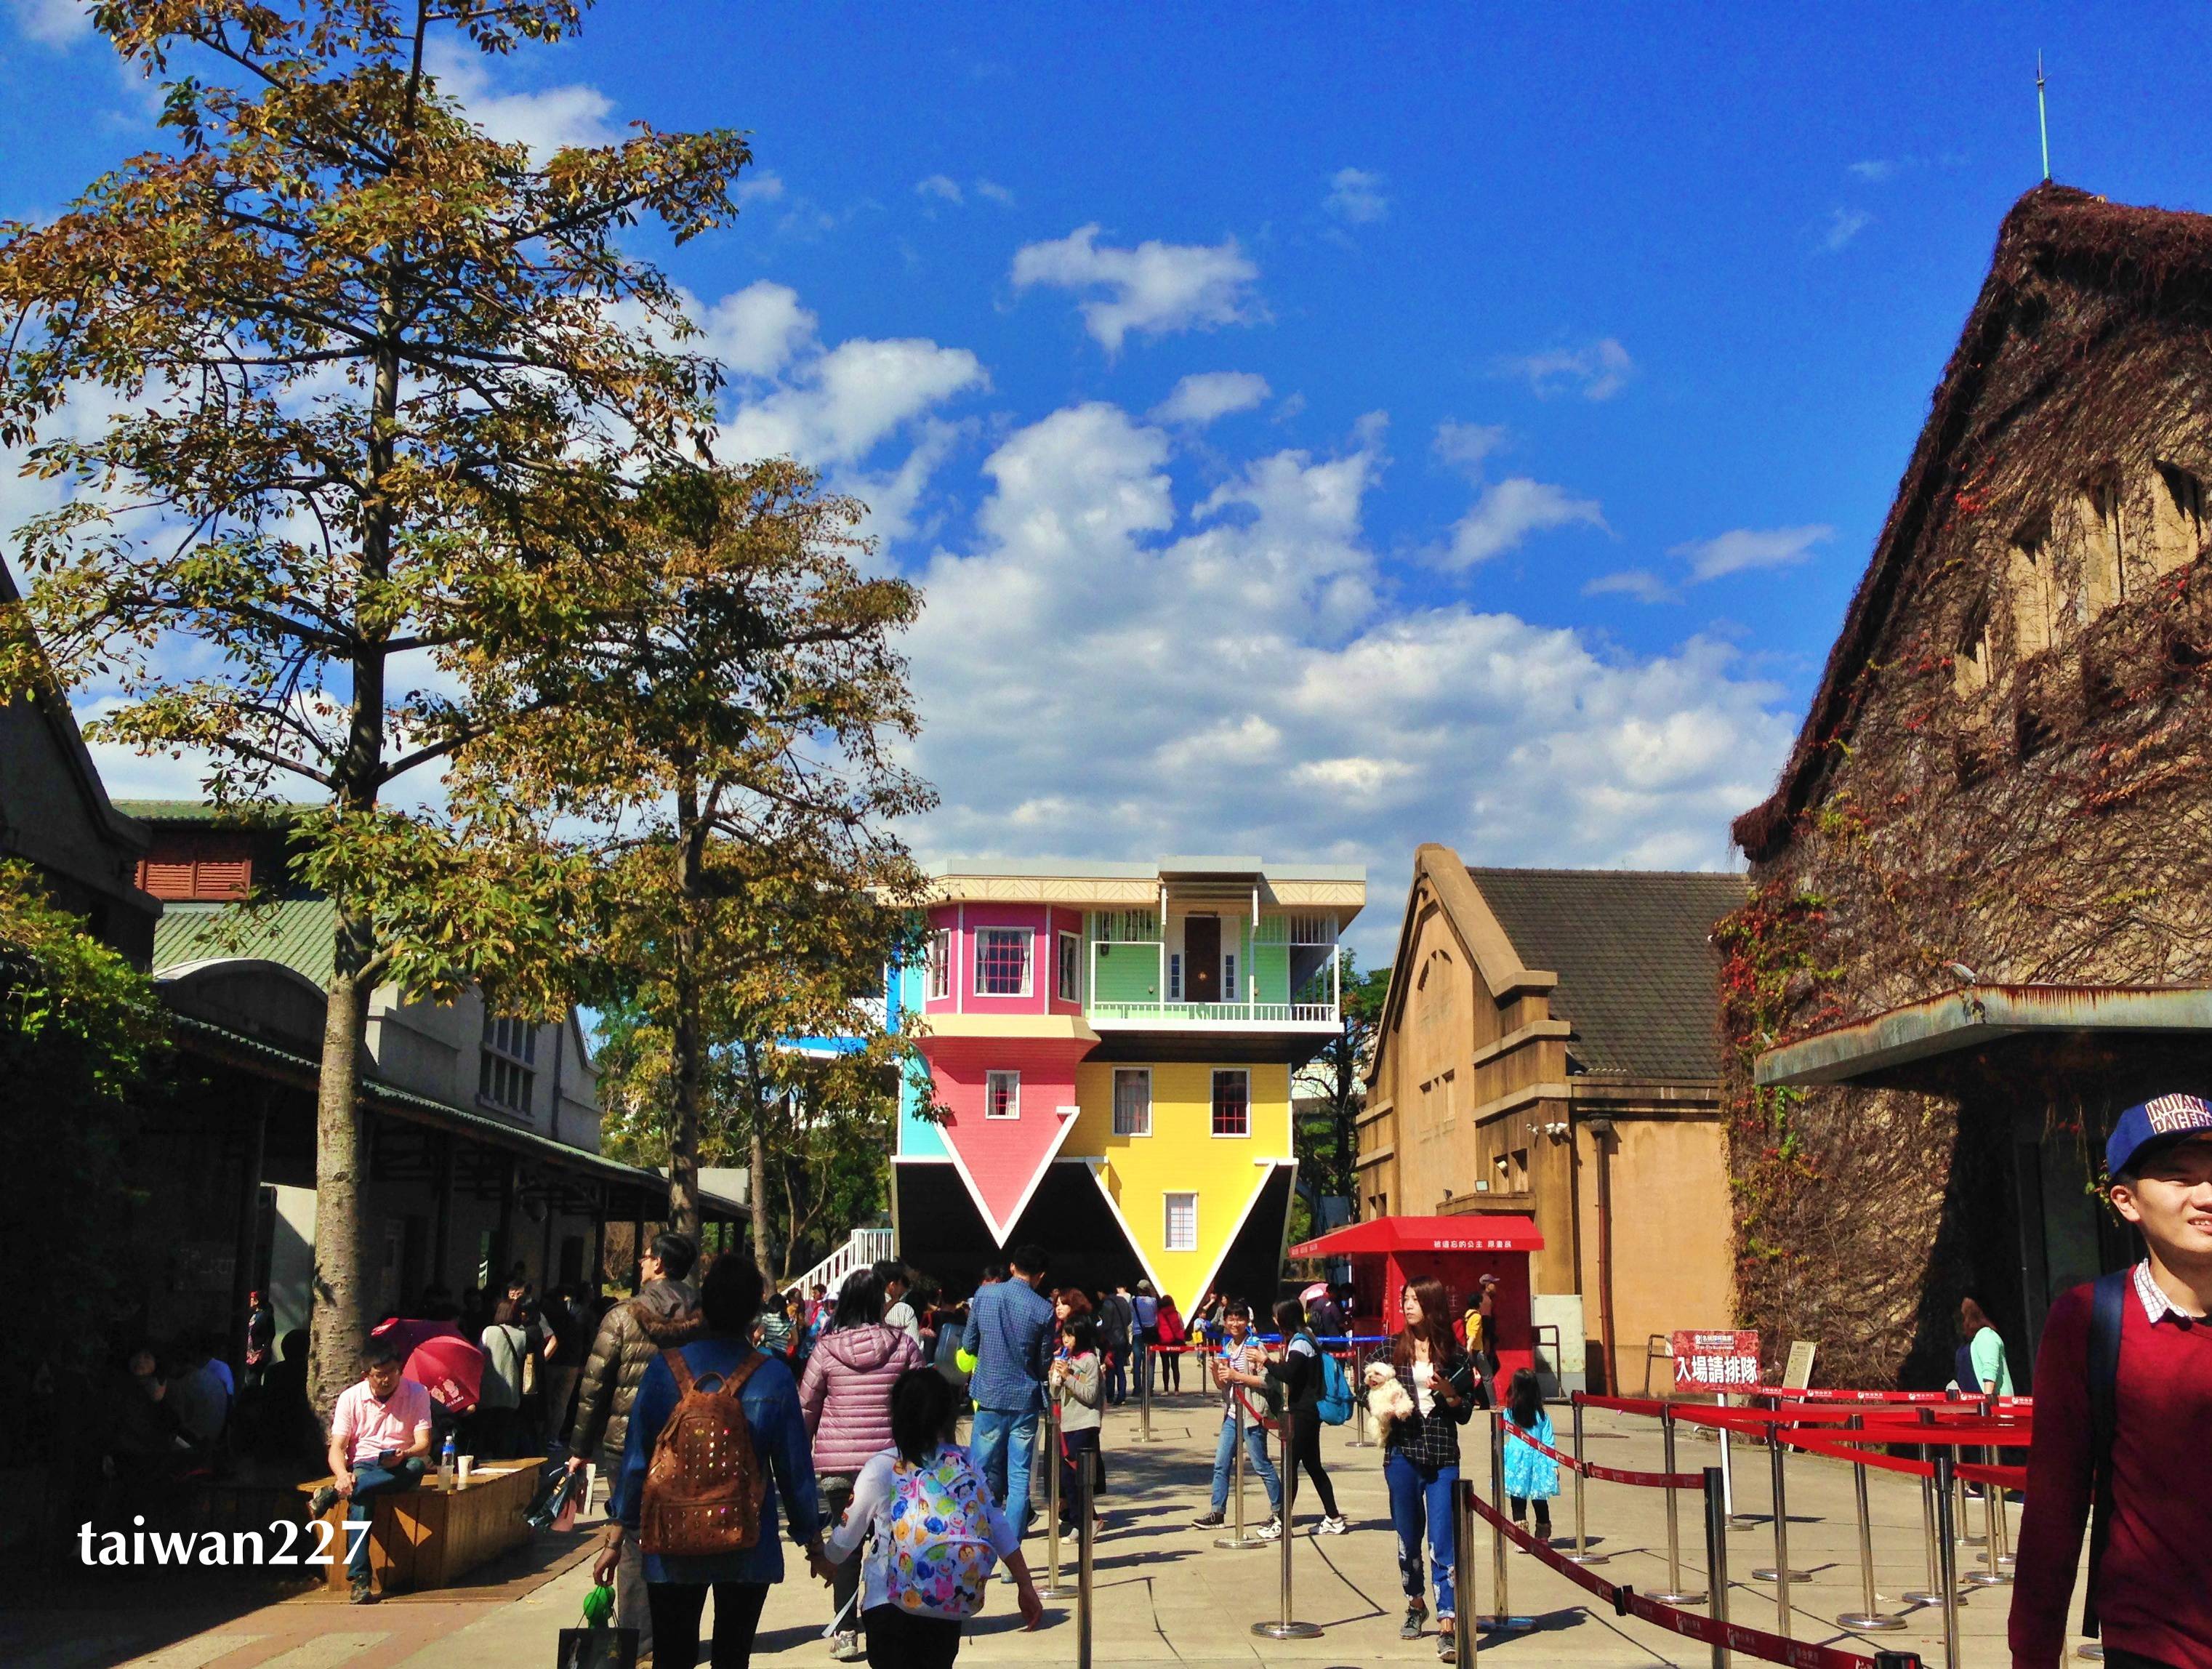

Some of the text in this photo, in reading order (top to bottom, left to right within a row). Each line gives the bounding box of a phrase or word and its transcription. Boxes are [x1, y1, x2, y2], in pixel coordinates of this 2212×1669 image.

[1676, 1355, 1758, 1384] 入場請排隊
